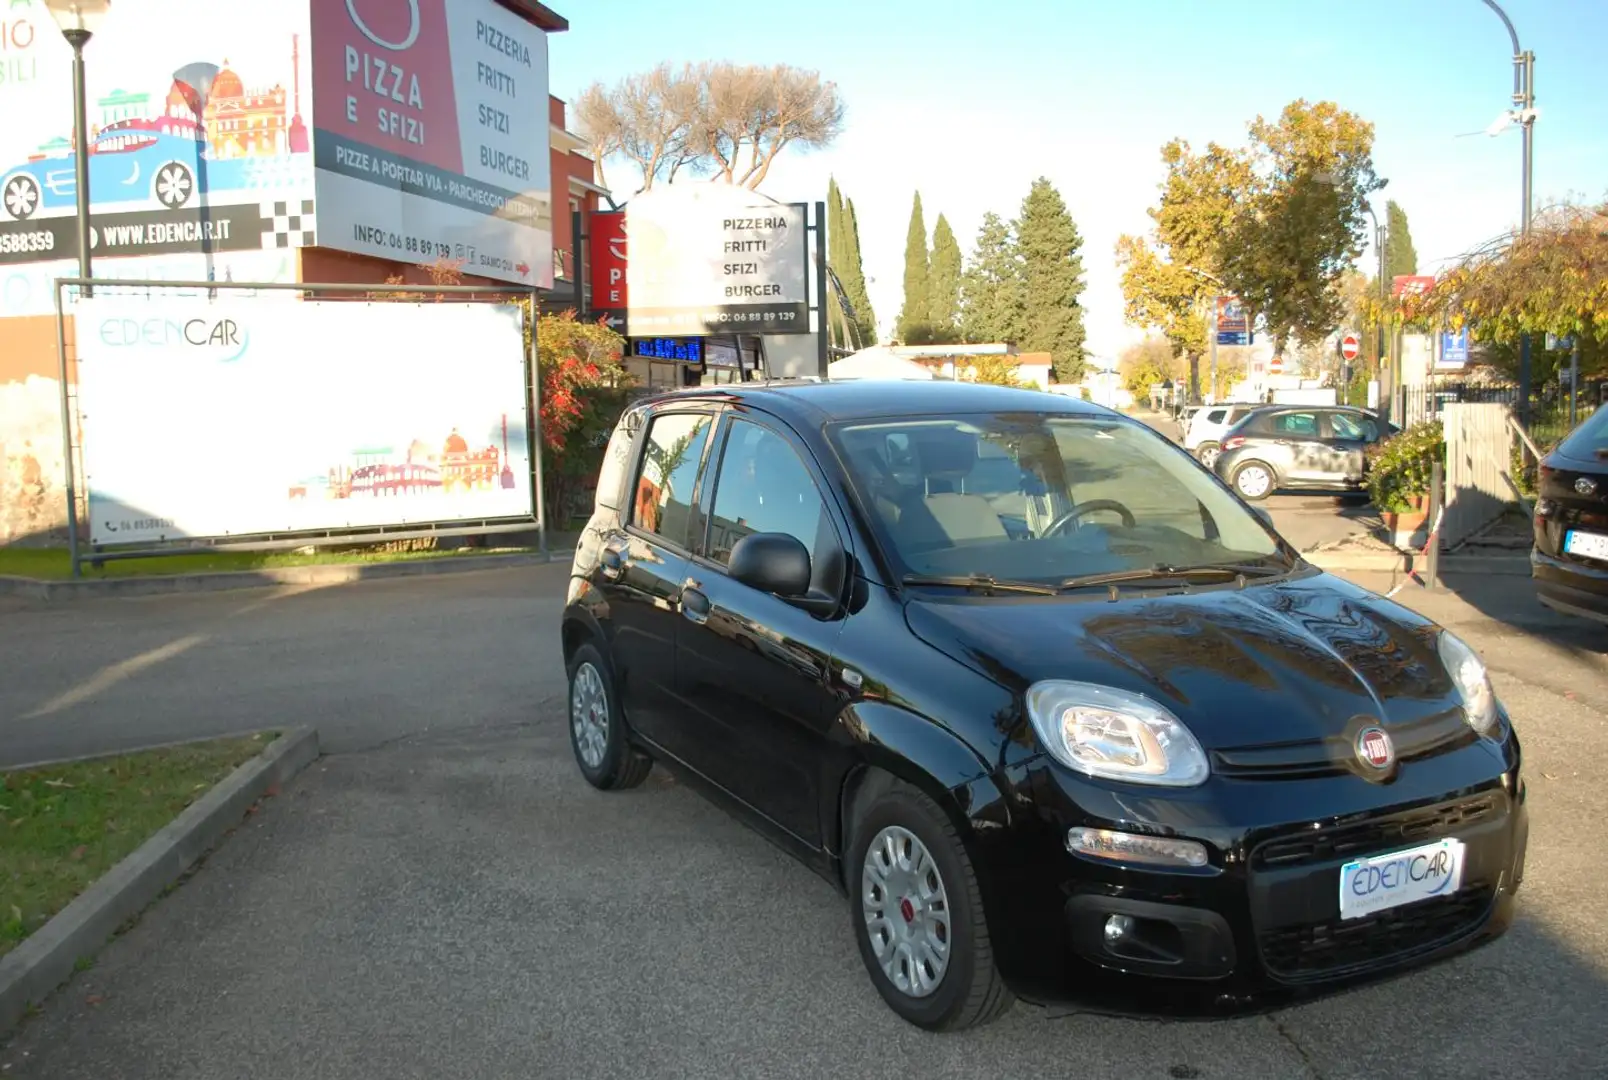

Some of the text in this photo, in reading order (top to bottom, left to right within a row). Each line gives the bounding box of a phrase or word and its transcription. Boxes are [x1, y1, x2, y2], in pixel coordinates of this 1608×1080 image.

[475, 19, 532, 68] PIZZERIA
[345, 44, 424, 110] PIZZA
[477, 61, 516, 98] FRITTI
[346, 95, 425, 145] E SFIZI
[478, 103, 510, 135] SFIZI
[336, 145, 370, 172] PIZZE
[371, 158, 380, 175] A
[381, 160, 424, 187] PORTAR
[425, 173, 442, 193] VIA
[449, 181, 504, 209] PARCHEGGIO
[480, 145, 530, 181] BURGER
[103, 219, 231, 246] WWW.EDENCAR.IT
[723, 217, 787, 230] PIZZERIA
[354, 223, 451, 259] INFO: 06 88 89 139
[724, 240, 767, 253] FRITTI
[724, 263, 757, 275] SFIZI
[725, 285, 781, 297] BURGER
[100, 318, 240, 346] EDENCAR
[734, 312, 747, 322] 06
[749, 312, 761, 321] 88
[763, 311, 776, 321] 89
[778, 311, 796, 321] 139
[1352, 850, 1448, 897] EDENCAR
